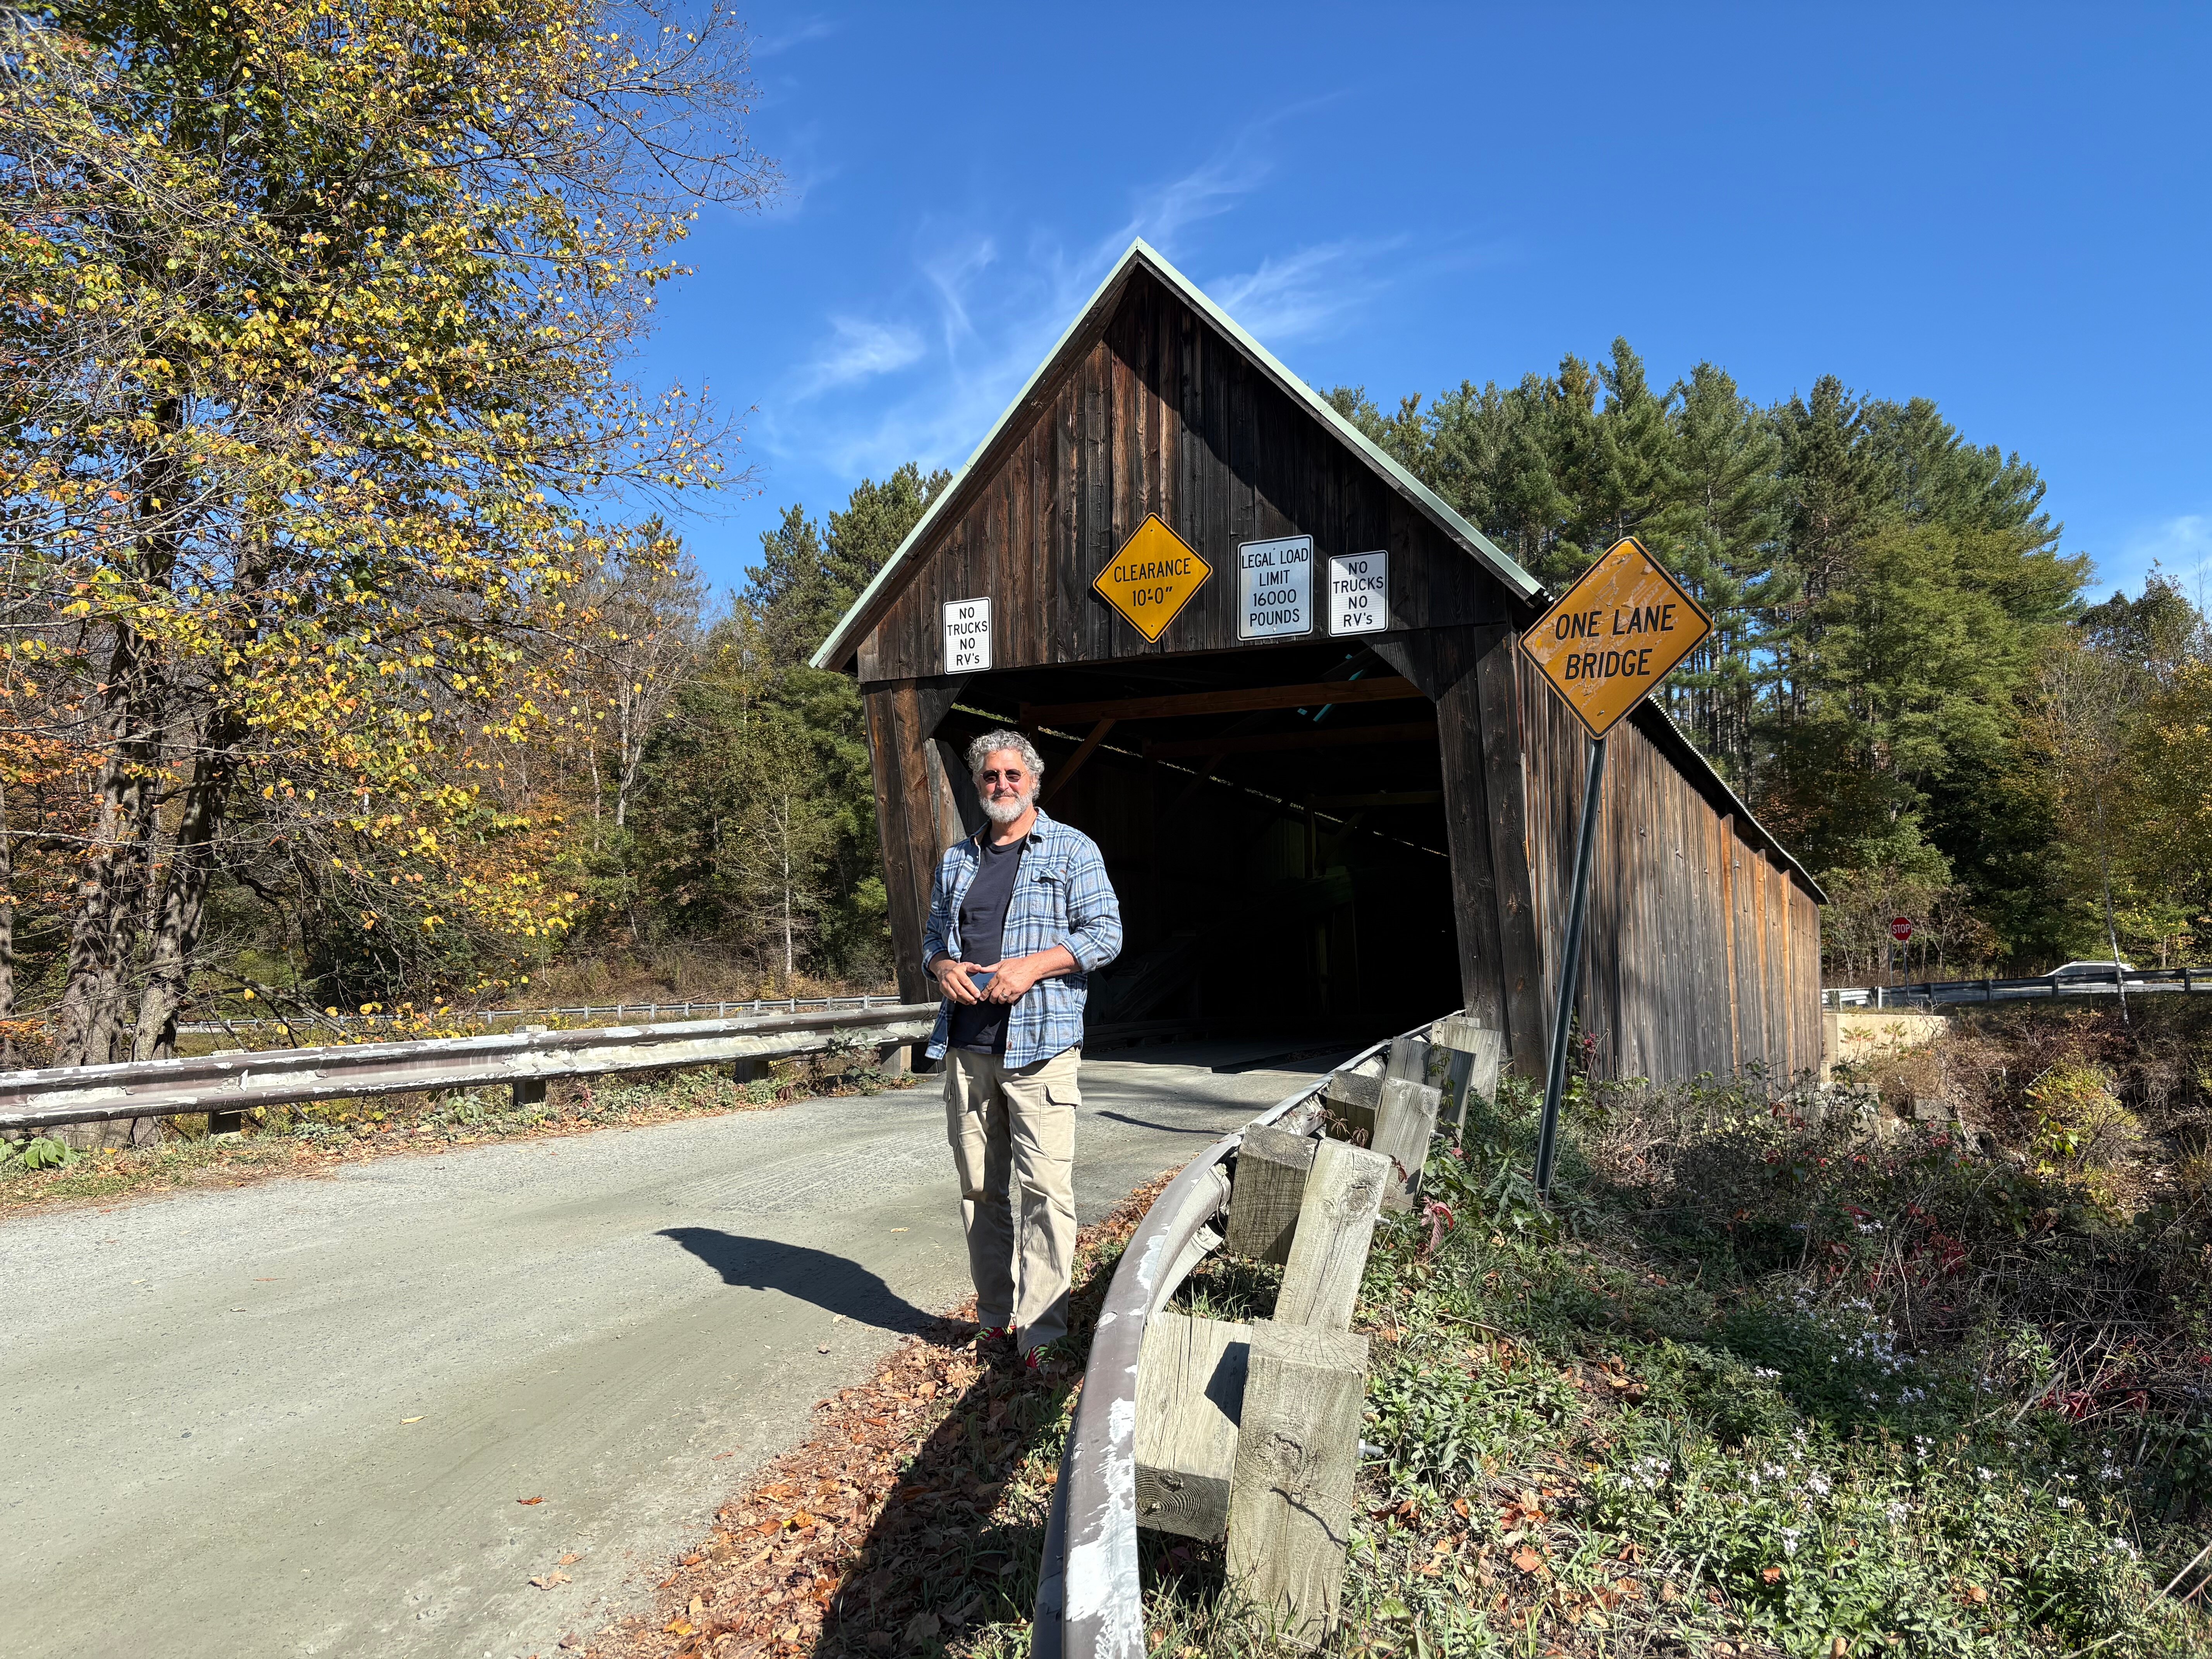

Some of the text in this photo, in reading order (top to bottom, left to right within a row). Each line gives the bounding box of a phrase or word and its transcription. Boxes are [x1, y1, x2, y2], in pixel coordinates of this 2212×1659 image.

[1242, 548, 1308, 568] LEGAL LOAD
[1114, 558, 1191, 583] CLEARANCE
[1348, 561, 1367, 575] NO
[1259, 570, 1290, 586] LIMIT
[1333, 576, 1383, 594] TRUCKS
[1253, 589, 1297, 606] 16000
[1348, 596, 1367, 610] NO
[959, 607, 974, 619] NO
[1250, 608, 1300, 627] POUNDS
[1343, 613, 1372, 627] RV's
[947, 621, 988, 636] TRUCKS
[1556, 604, 1676, 640] ONE LANE
[960, 637, 975, 650] NO
[957, 653, 979, 666] RV's
[1565, 649, 1653, 680] BRIDGE
[1893, 924, 1910, 934] STOP
